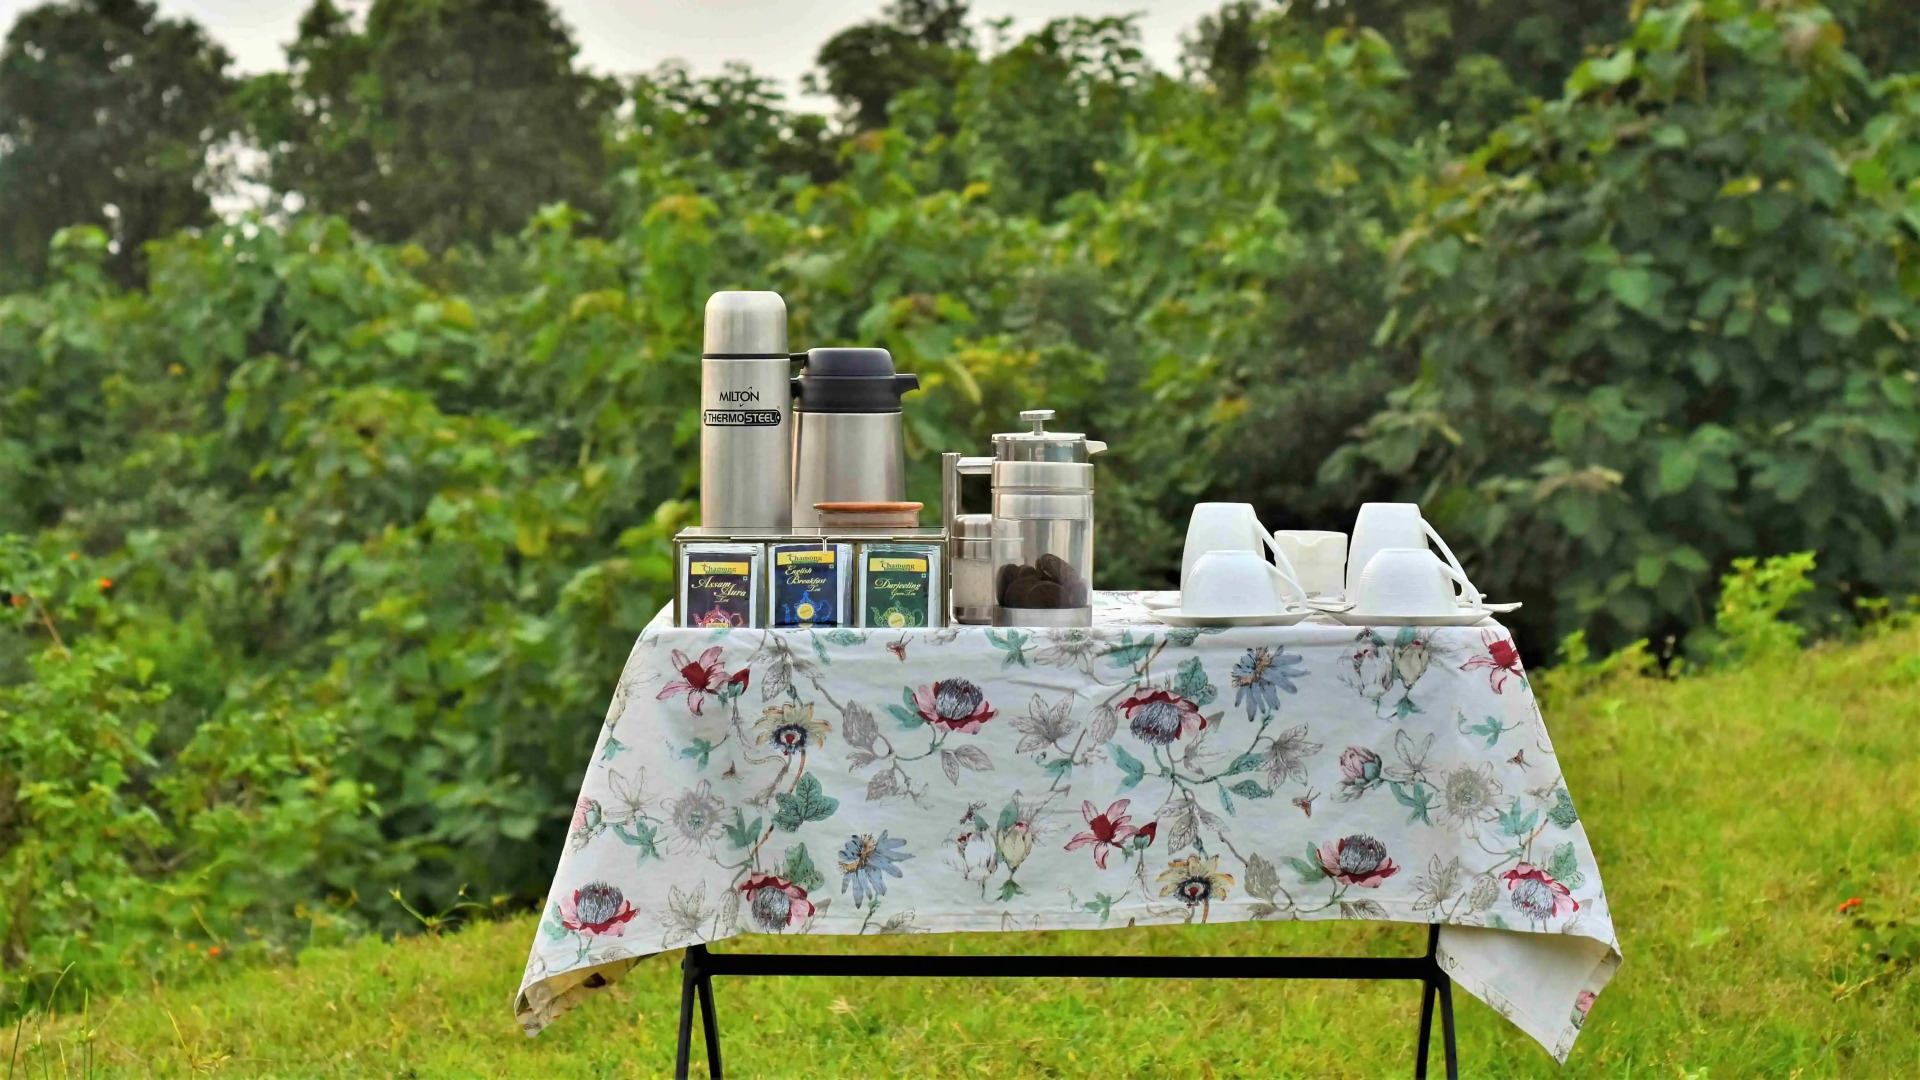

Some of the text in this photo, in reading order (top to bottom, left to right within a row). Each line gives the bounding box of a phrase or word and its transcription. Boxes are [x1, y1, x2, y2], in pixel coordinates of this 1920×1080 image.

[719, 390, 760, 402] MILTON
[706, 412, 776, 424] THERMOSTEEL
[785, 565, 812, 576] English
[691, 576, 732, 589] Assam
[786, 575, 827, 585] Breakfast
[874, 578, 922, 591] Darjeeling
[713, 584, 747, 597] Aura
